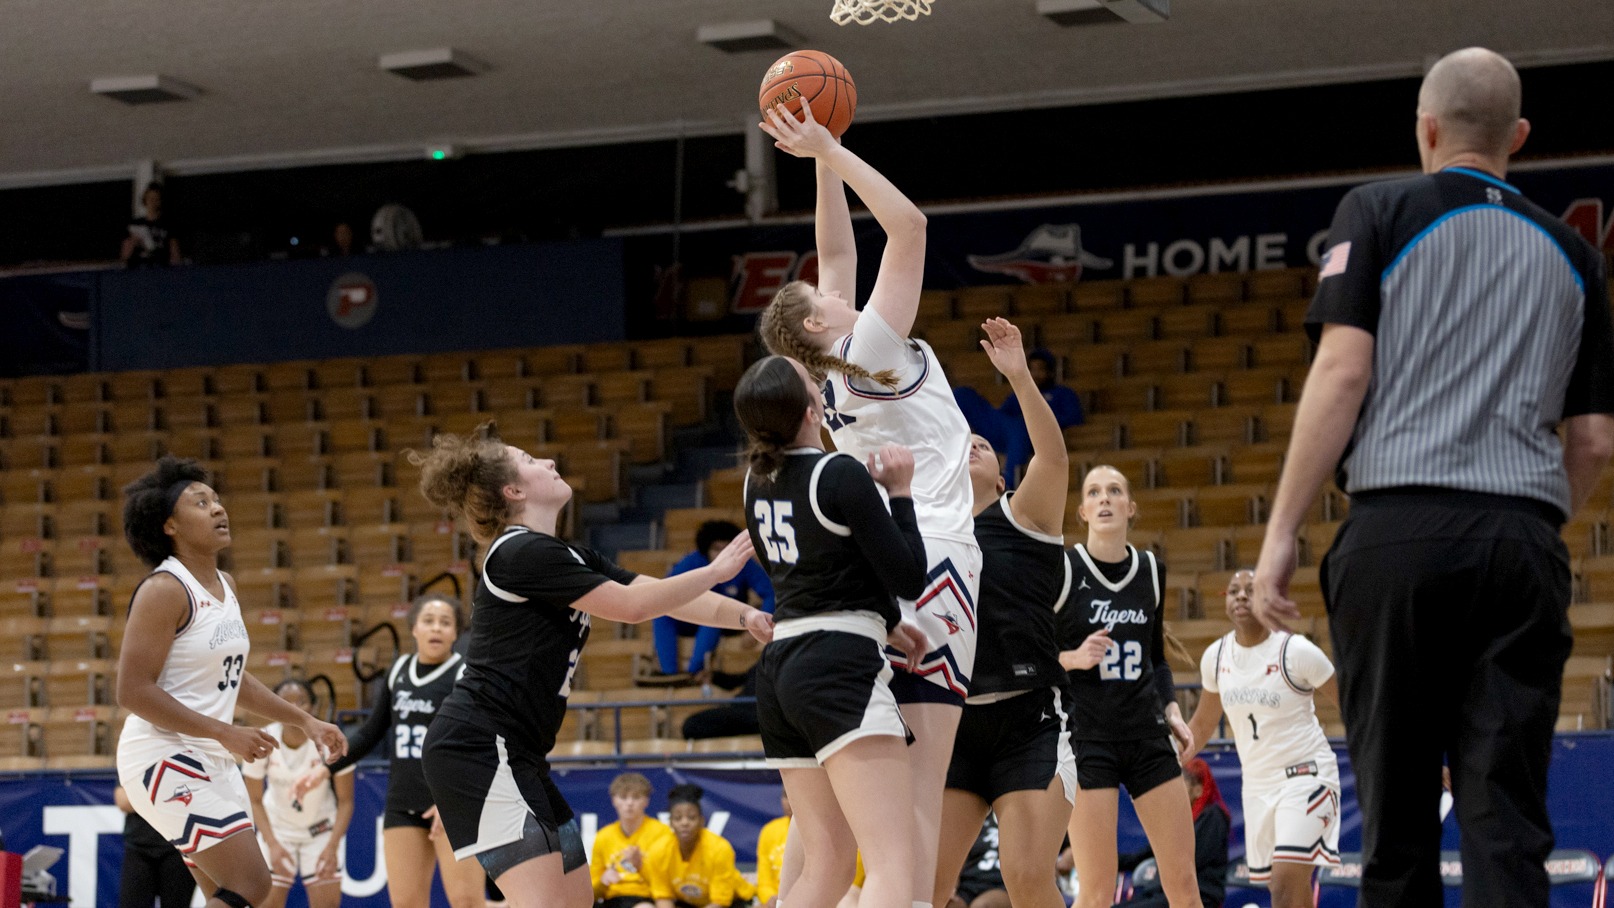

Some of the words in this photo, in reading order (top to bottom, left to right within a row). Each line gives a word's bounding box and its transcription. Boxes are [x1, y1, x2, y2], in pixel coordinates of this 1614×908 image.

[1122, 233, 1288, 281] HOME
[753, 498, 800, 566] 25
[1088, 598, 1148, 634] Tigers
[217, 654, 244, 692] 33
[1099, 640, 1143, 681] 22
[392, 689, 436, 720] Tigers
[394, 723, 429, 759] 23
[1247, 712, 1260, 742] 1
